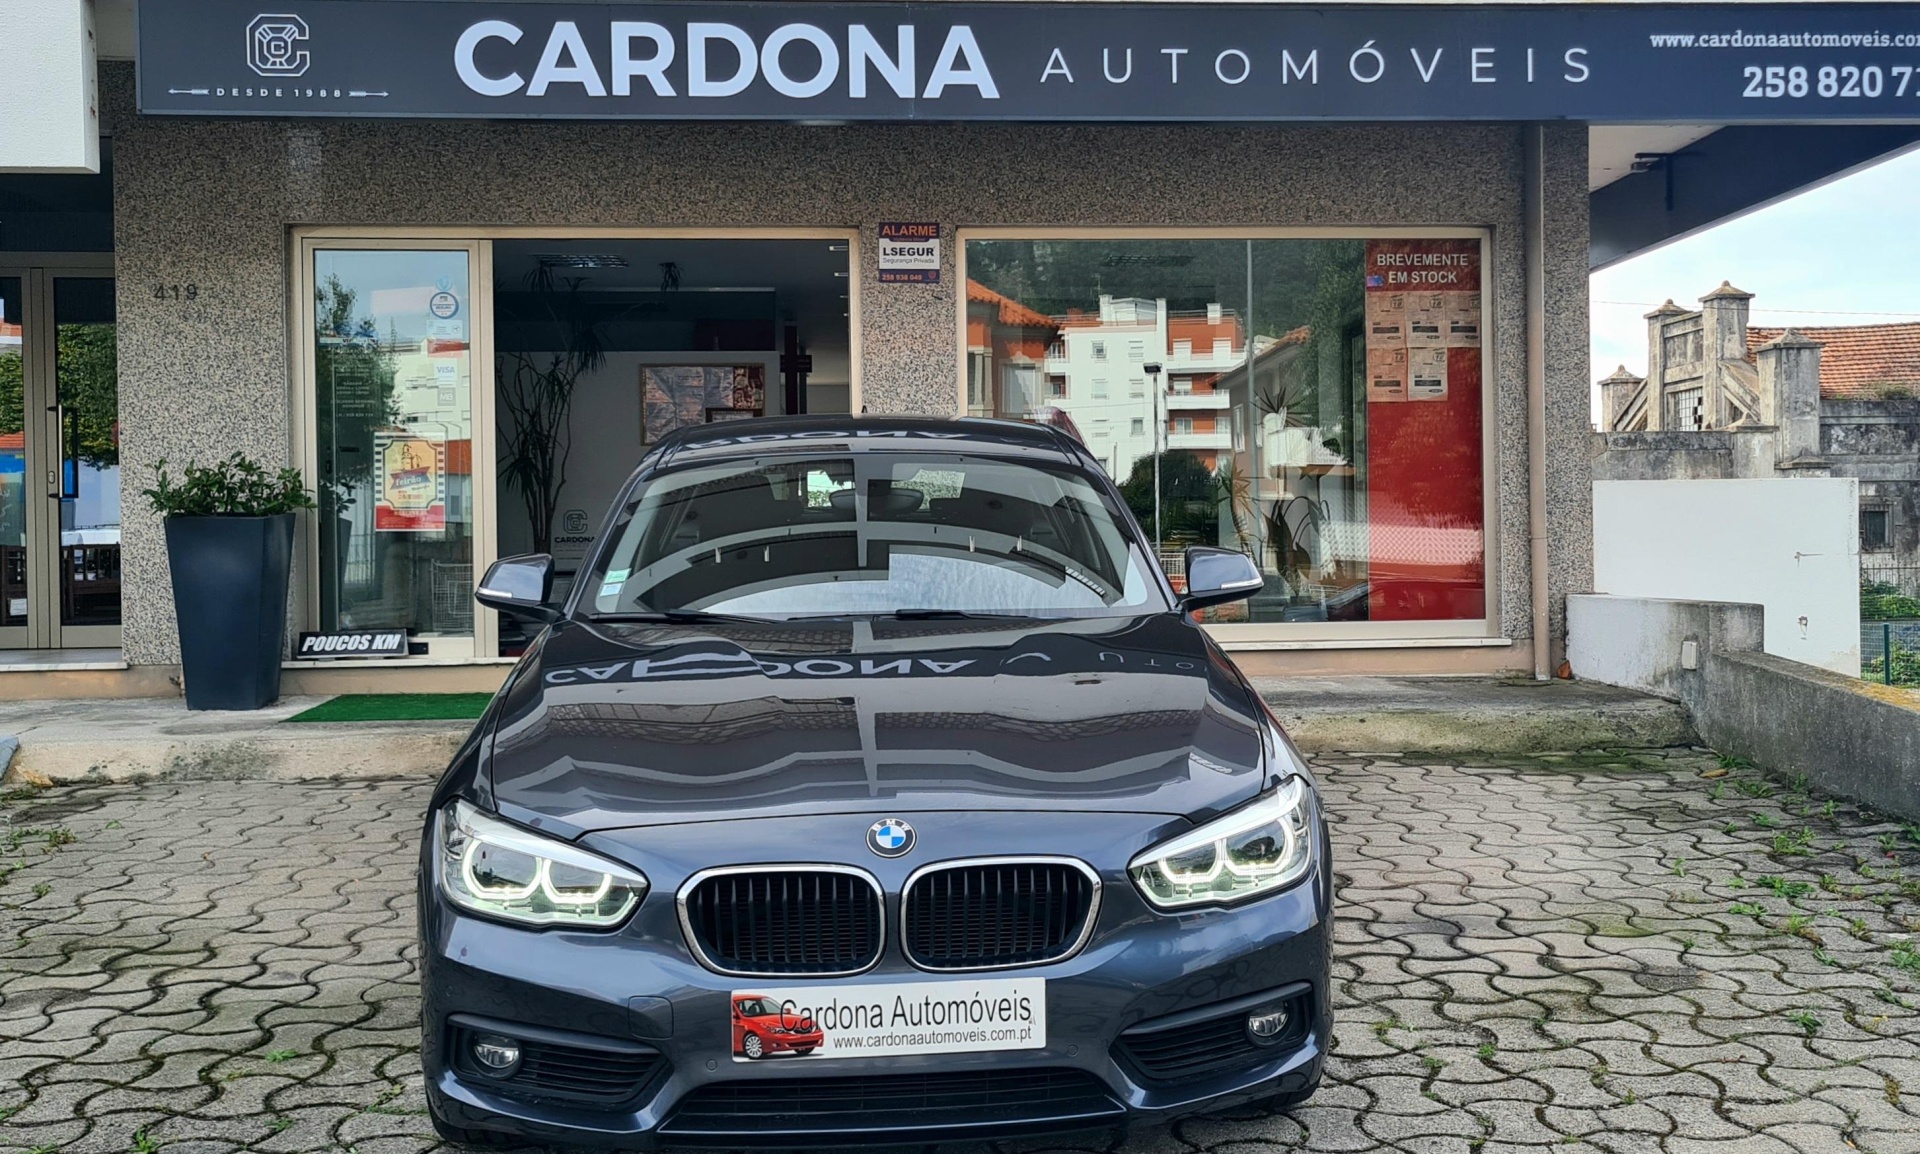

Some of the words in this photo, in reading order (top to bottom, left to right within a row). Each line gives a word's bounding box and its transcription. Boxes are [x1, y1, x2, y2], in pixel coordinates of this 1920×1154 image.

[454, 20, 1000, 98] CARDONA
[1040, 40, 1591, 84] AUTOMÓVEIS
[1743, 66, 1808, 97] 258
[1817, 66, 1883, 97] 820
[216, 88, 283, 97] DESDE
[294, 88, 341, 98] 1988
[881, 225, 937, 236] ALARME
[883, 247, 935, 256] LSEGUR
[883, 257, 912, 265] Segurança
[1377, 254, 1468, 266] BREVEMENTE
[1389, 271, 1407, 283] EM
[1412, 271, 1457, 283] STOCK
[153, 284, 197, 301] 419
[437, 366, 455, 374] VISA
[302, 634, 372, 651] POUCOS
[371, 634, 402, 650] KM
[870, 819, 912, 831] BMW
[779, 996, 883, 1032] Cardona
[890, 989, 1031, 1027] Automóveis
[833, 1025, 1032, 1050] www.cardonaautomoveis.com.pt
